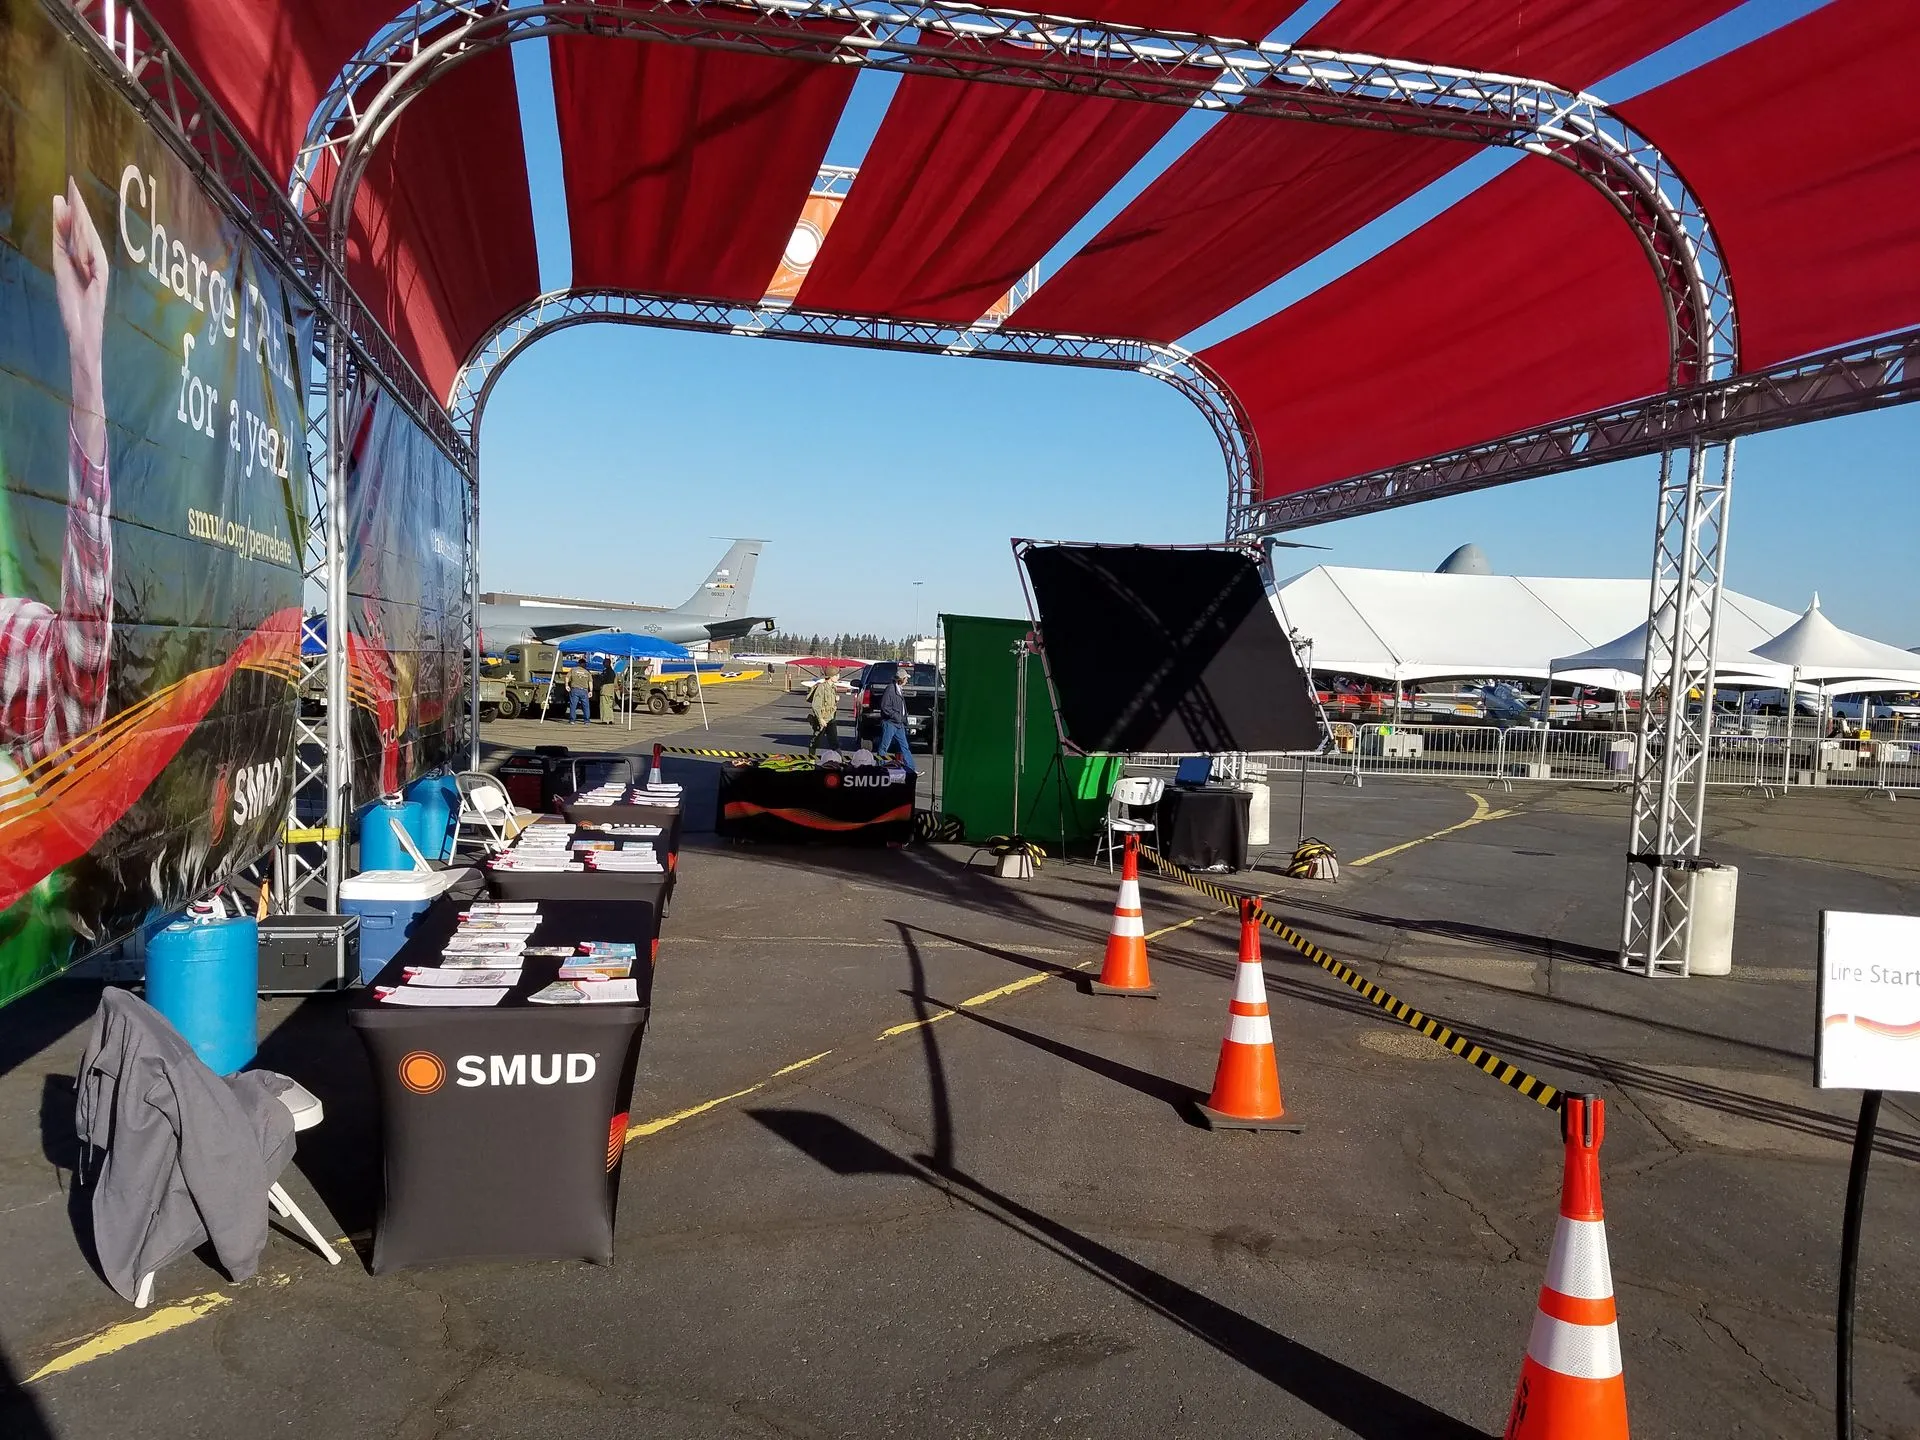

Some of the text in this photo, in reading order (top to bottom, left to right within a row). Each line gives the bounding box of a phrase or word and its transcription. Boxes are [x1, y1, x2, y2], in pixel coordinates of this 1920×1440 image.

[119, 164, 236, 346] Charge
[177, 332, 218, 438] for
[229, 399, 241, 452] a
[187, 502, 292, 564] smud.org/pevrebate
[843, 775, 892, 787] SMUD
[456, 1052, 597, 1088] SMUD
